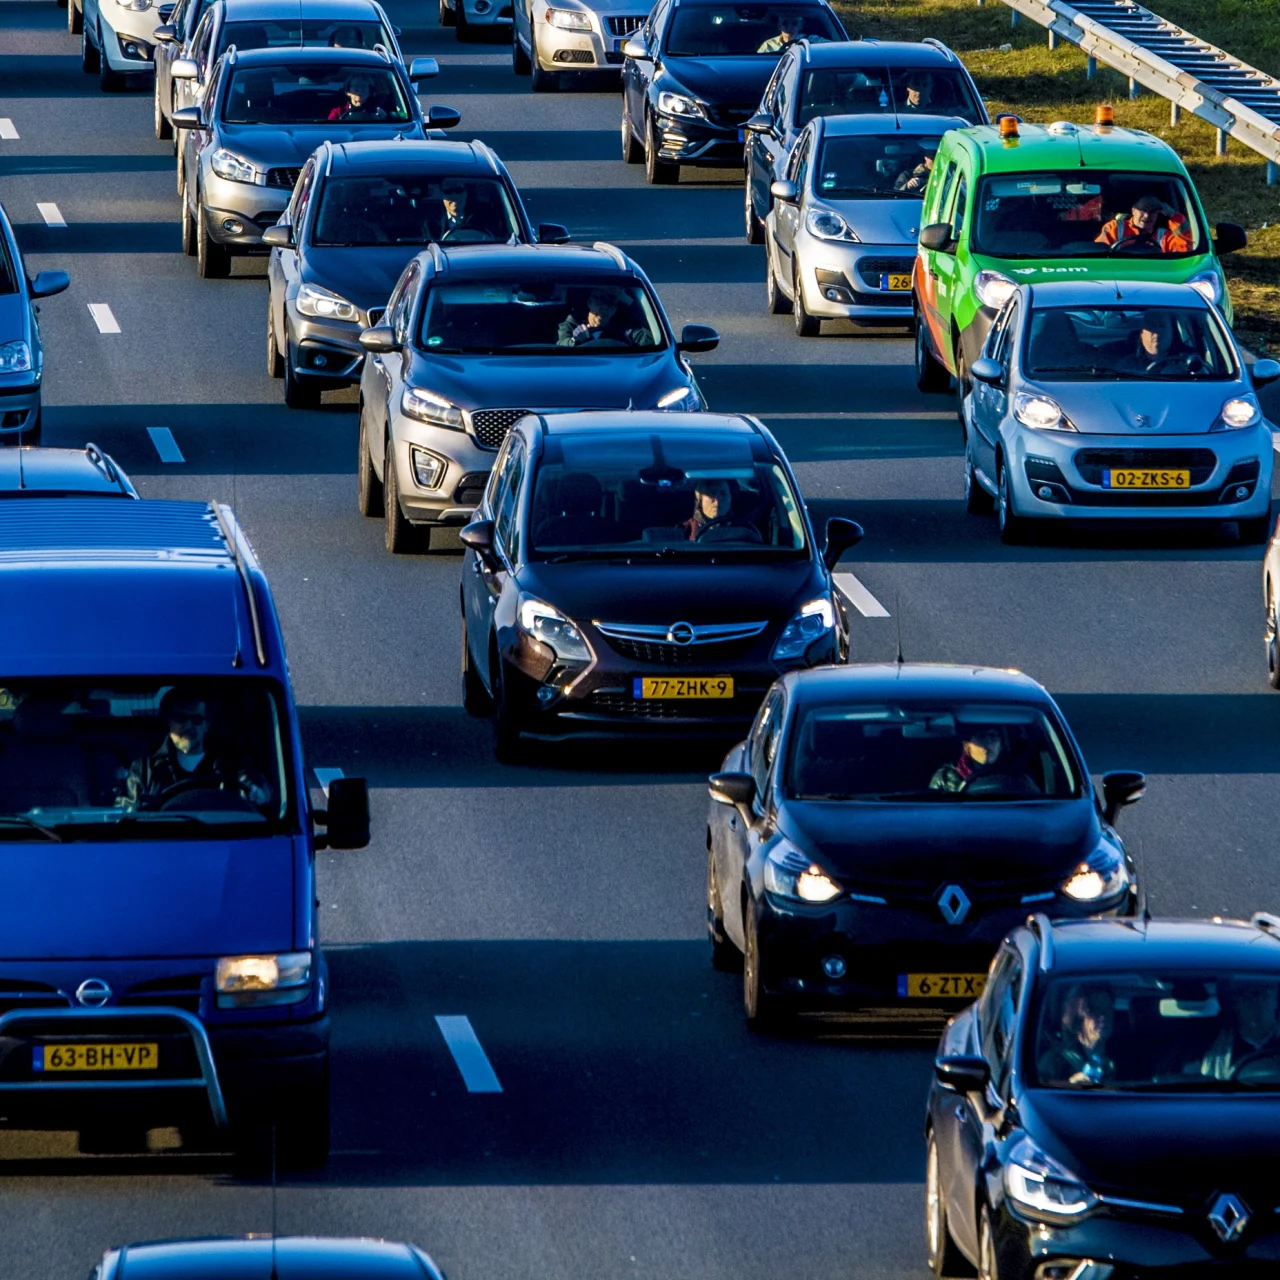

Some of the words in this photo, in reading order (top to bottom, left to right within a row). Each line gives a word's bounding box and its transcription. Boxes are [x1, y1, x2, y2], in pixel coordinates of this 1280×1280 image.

[1115, 472, 1184, 486] 02-ZKS-6
[650, 680, 727, 696] 77-ZHK-9
[50, 1047, 150, 1068] 63-BH-VP
